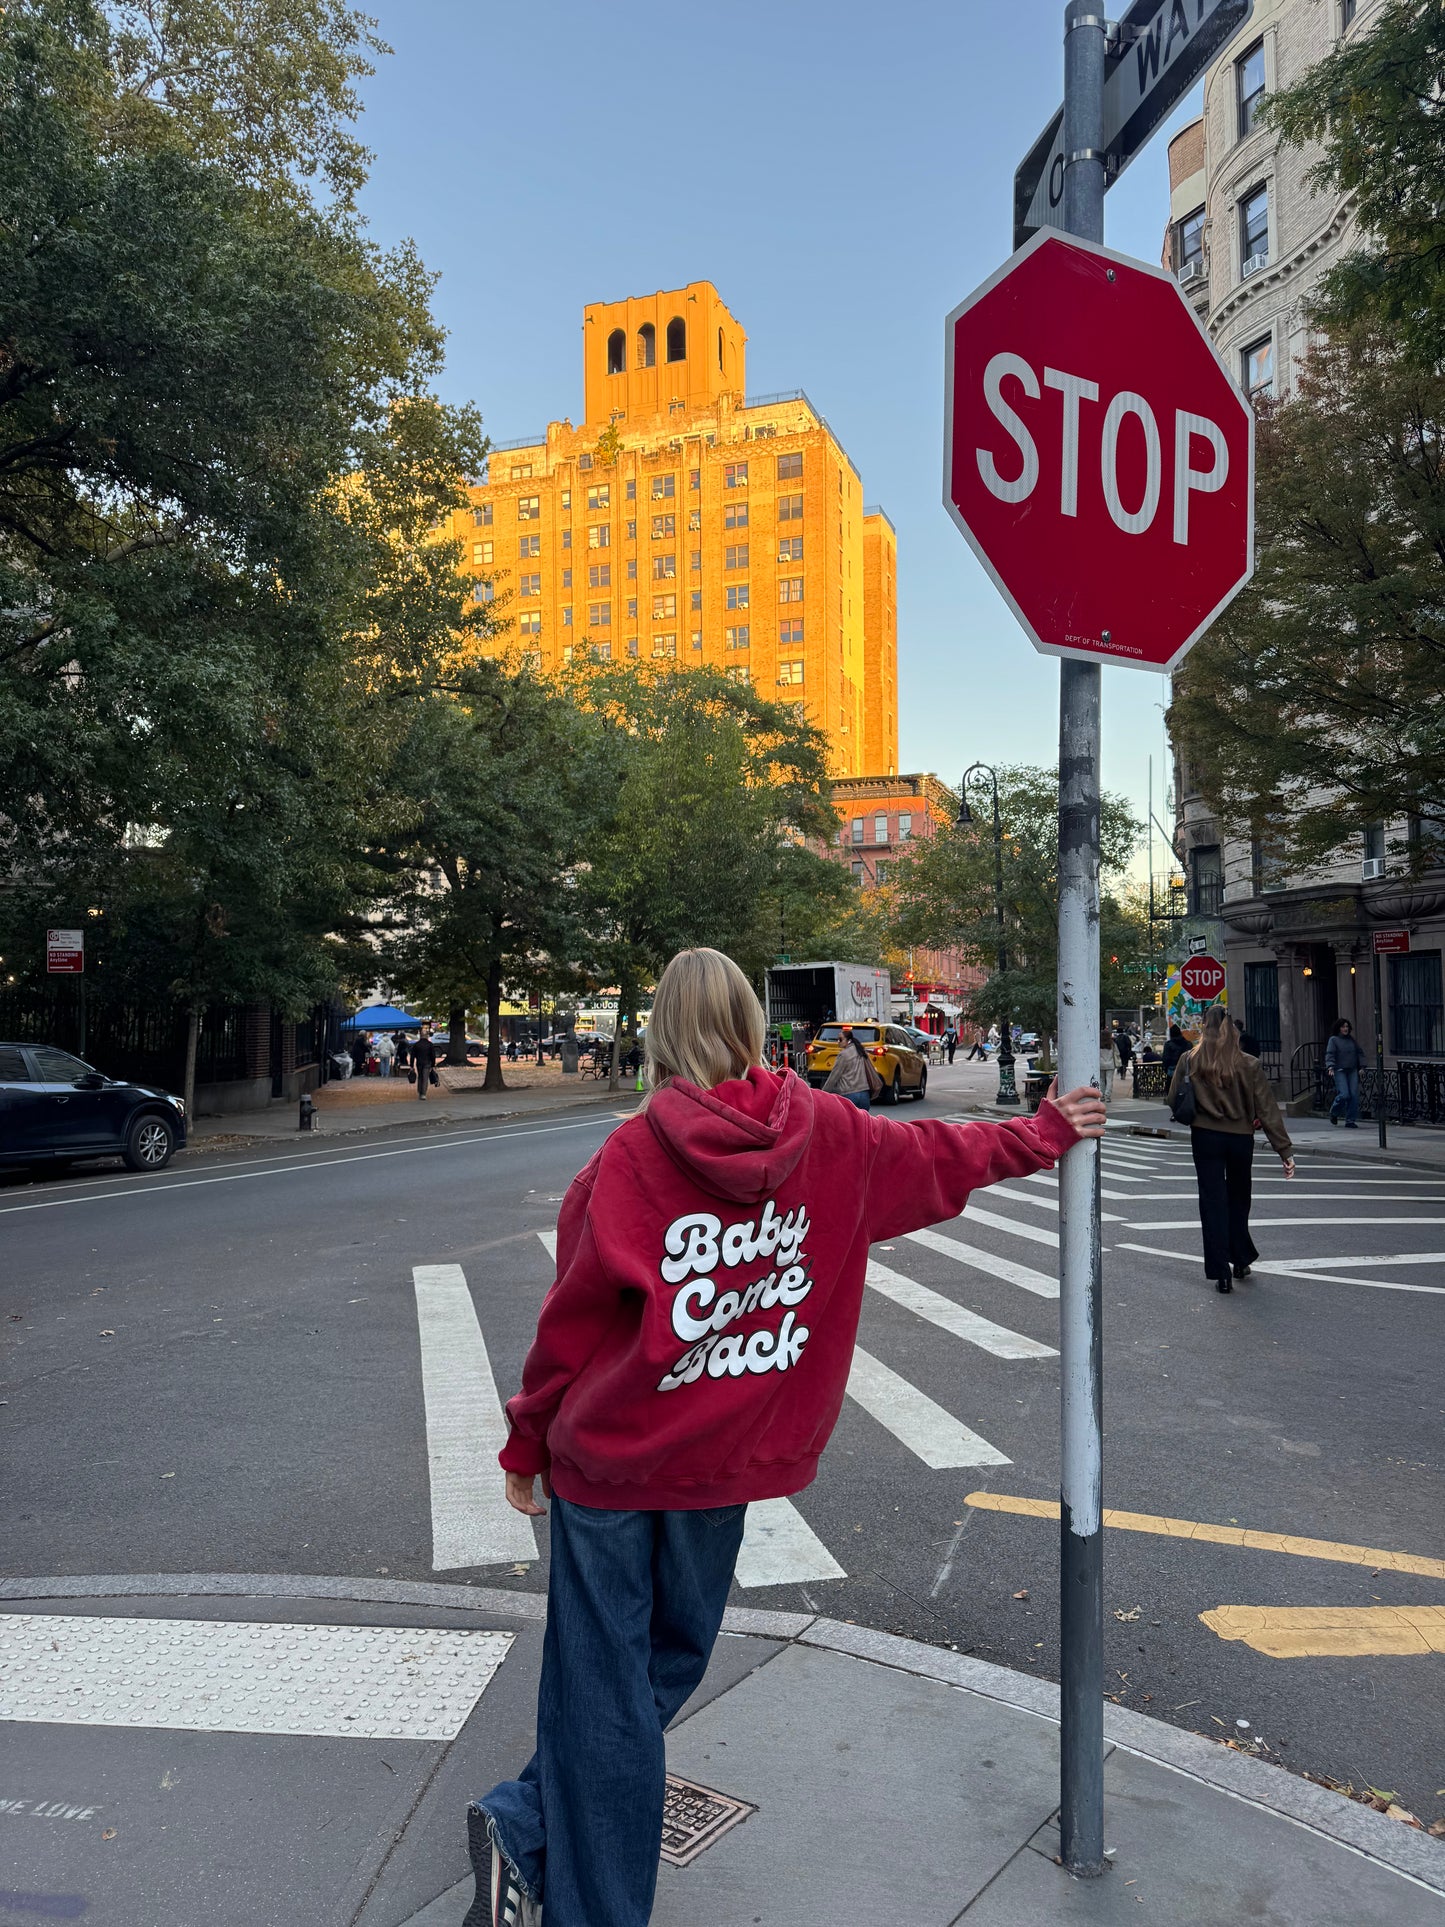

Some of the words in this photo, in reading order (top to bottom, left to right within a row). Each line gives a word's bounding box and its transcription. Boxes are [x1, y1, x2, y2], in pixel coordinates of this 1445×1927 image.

[1136, 0, 1204, 96] WA
[976, 352, 1229, 546] STOP
[1065, 634, 1081, 643] DEPT
[1092, 640, 1143, 655] TRANSPORTATION
[856, 981, 872, 1000] Ryder
[1184, 969, 1222, 986] STOP
[660, 1199, 811, 1283] Baby
[671, 1265, 813, 1342] Come
[656, 1310, 810, 1392] Back
[32, 1800, 104, 1820] LOVE
[665, 1788, 723, 1815] REMOVA
